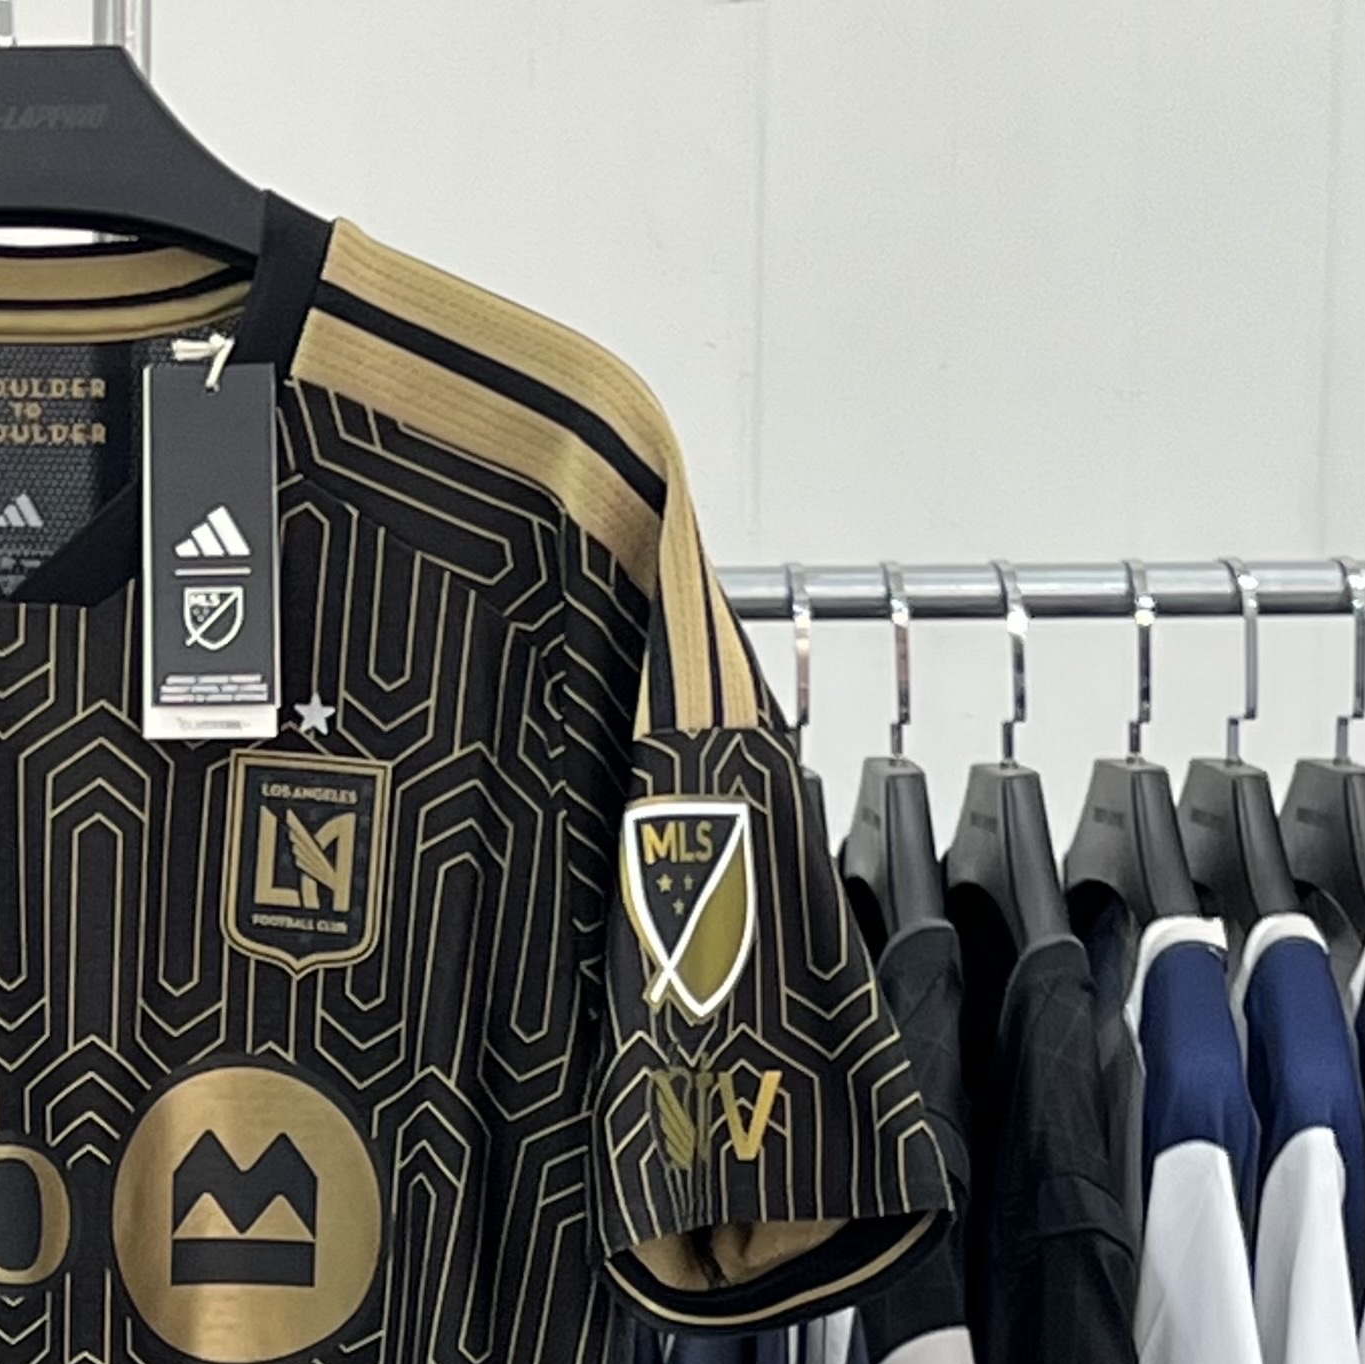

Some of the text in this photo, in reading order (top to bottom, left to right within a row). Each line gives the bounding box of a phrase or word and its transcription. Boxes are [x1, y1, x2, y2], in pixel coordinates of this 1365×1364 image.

[12, 402, 43, 419] TO
[261, 782, 358, 805] LOS ANGELES
[641, 820, 713, 866] MLS
[251, 912, 315, 931] FOOTBALL
